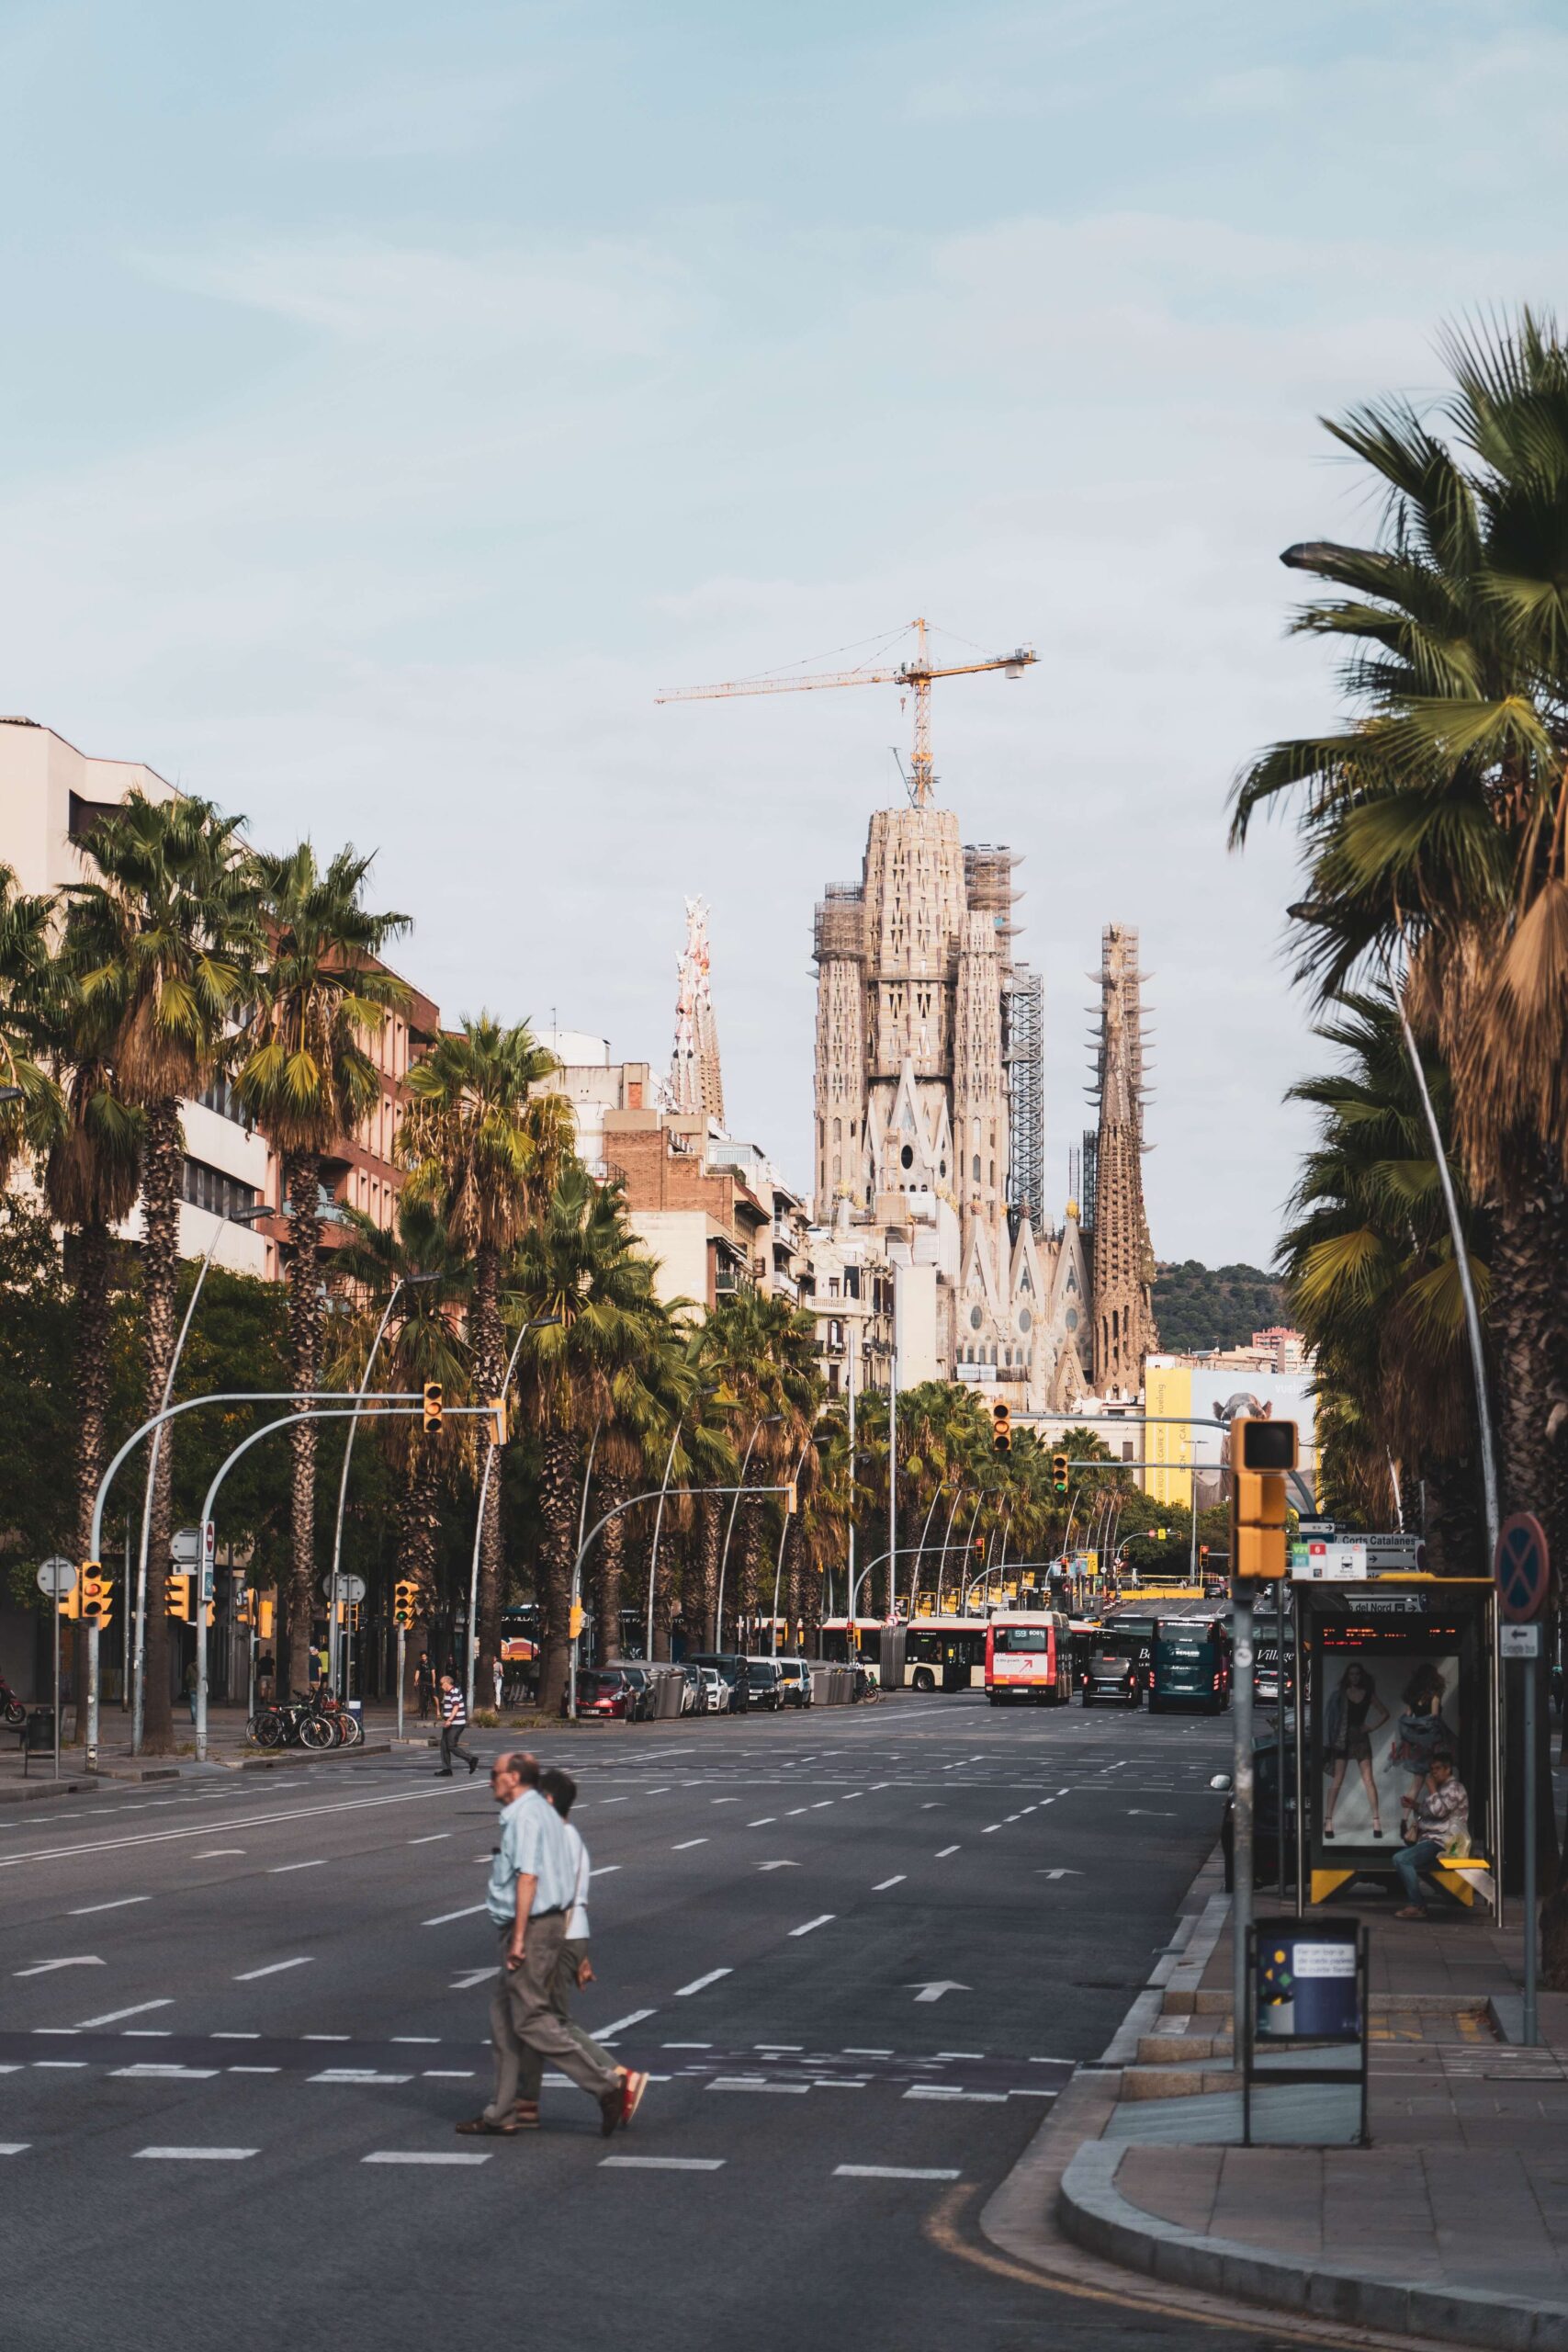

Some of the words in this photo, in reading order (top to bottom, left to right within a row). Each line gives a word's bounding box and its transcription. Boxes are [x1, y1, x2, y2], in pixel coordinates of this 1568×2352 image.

[1156, 1384, 1166, 1414] vueling
[1342, 1535, 1368, 1545] Corts
[1370, 1535, 1416, 1545] Catalanes
[1314, 1545, 1321, 1554] 6
[1356, 1603, 1369, 1612] del
[1371, 1603, 1392, 1612] Nord
[1014, 1630, 1027, 1638] 59
[1257, 1649, 1295, 1663] Villge
